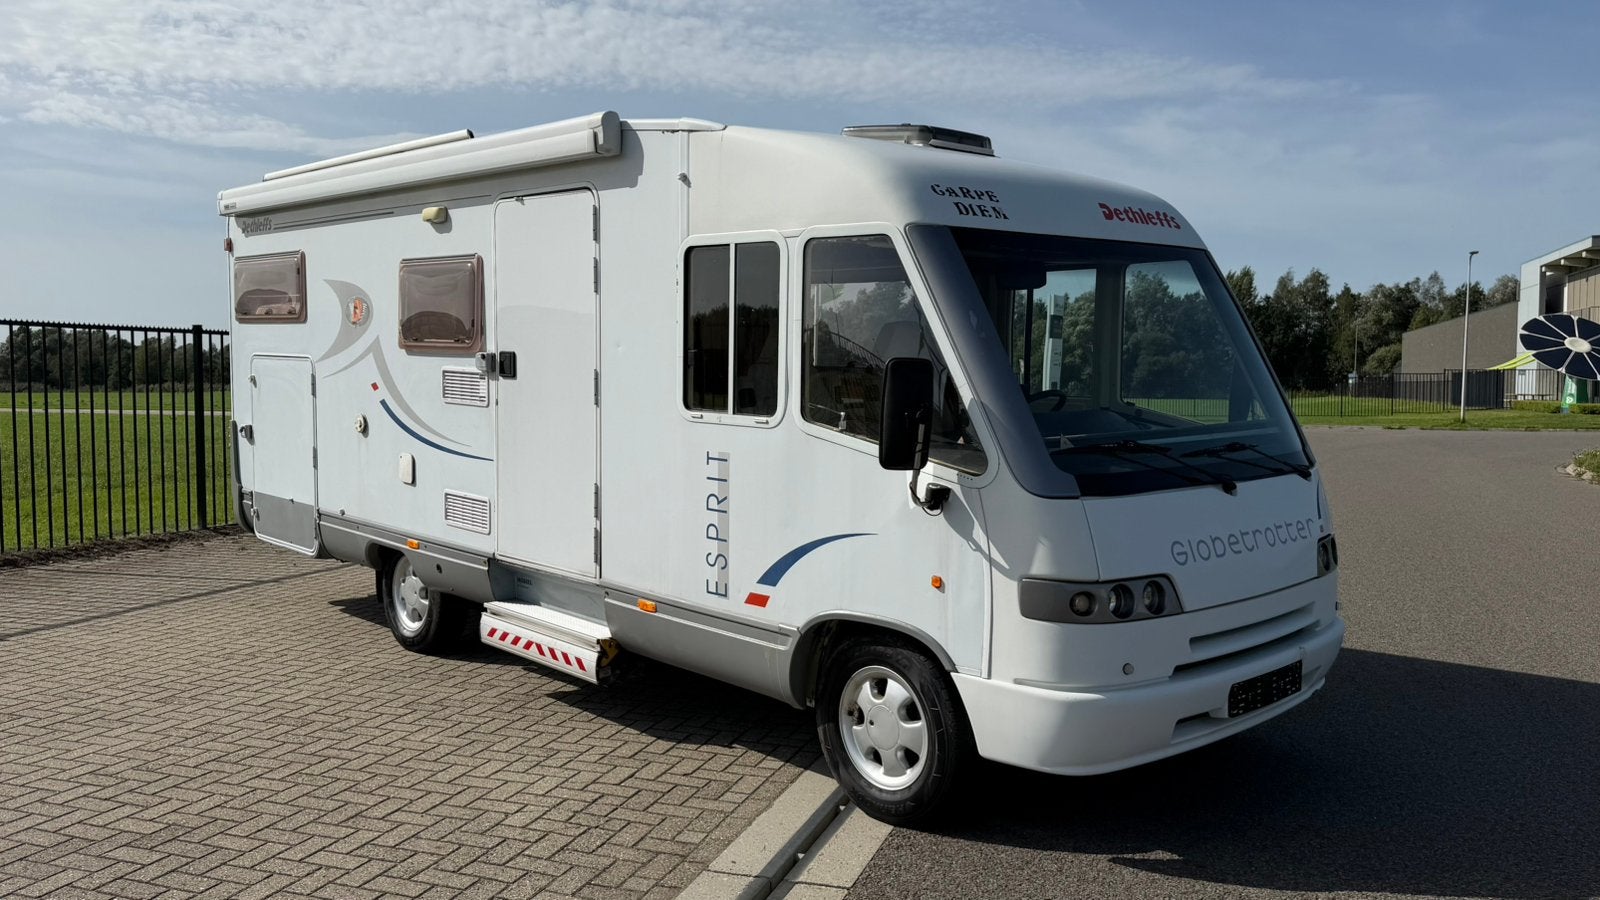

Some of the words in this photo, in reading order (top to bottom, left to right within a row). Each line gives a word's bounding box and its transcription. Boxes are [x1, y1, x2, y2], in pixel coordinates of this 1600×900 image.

[952, 201, 1010, 220] DIEM
[1098, 202, 1181, 230] Dethleffs
[241, 216, 273, 234] Dethleffs
[706, 451, 728, 599] ESPRIT
[1170, 517, 1314, 567] Globetrotter
